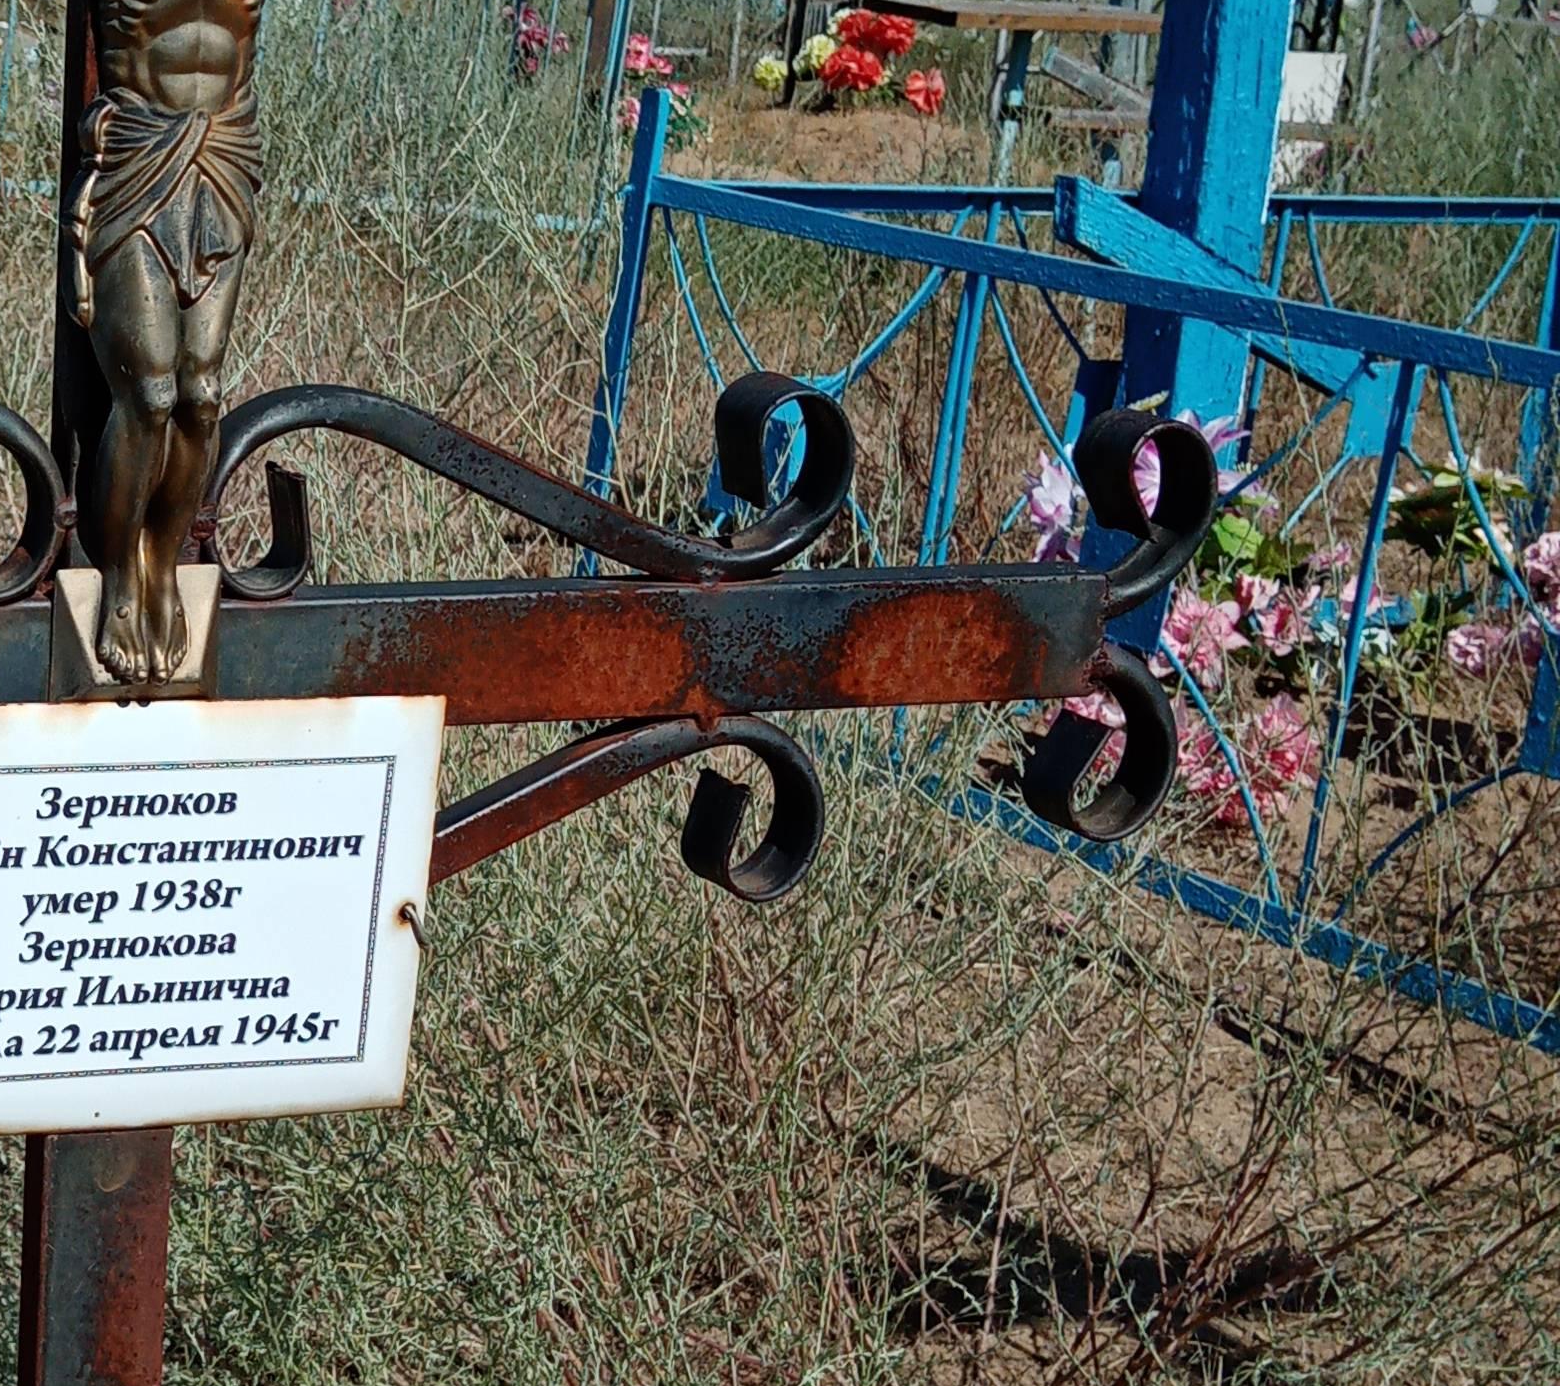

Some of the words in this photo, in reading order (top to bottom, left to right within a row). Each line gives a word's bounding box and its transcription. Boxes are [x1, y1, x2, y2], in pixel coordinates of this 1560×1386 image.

[36, 788, 238, 828] Зернюков
[33, 834, 363, 867] Константинович
[20, 890, 119, 926] умер
[130, 878, 242, 912] 1938г
[19, 932, 237, 971] Зернюкова
[74, 976, 290, 1007] Ильинична
[33, 1024, 80, 1055] 22
[90, 1025, 221, 1061] апреля
[231, 1011, 339, 1045] 1945г
